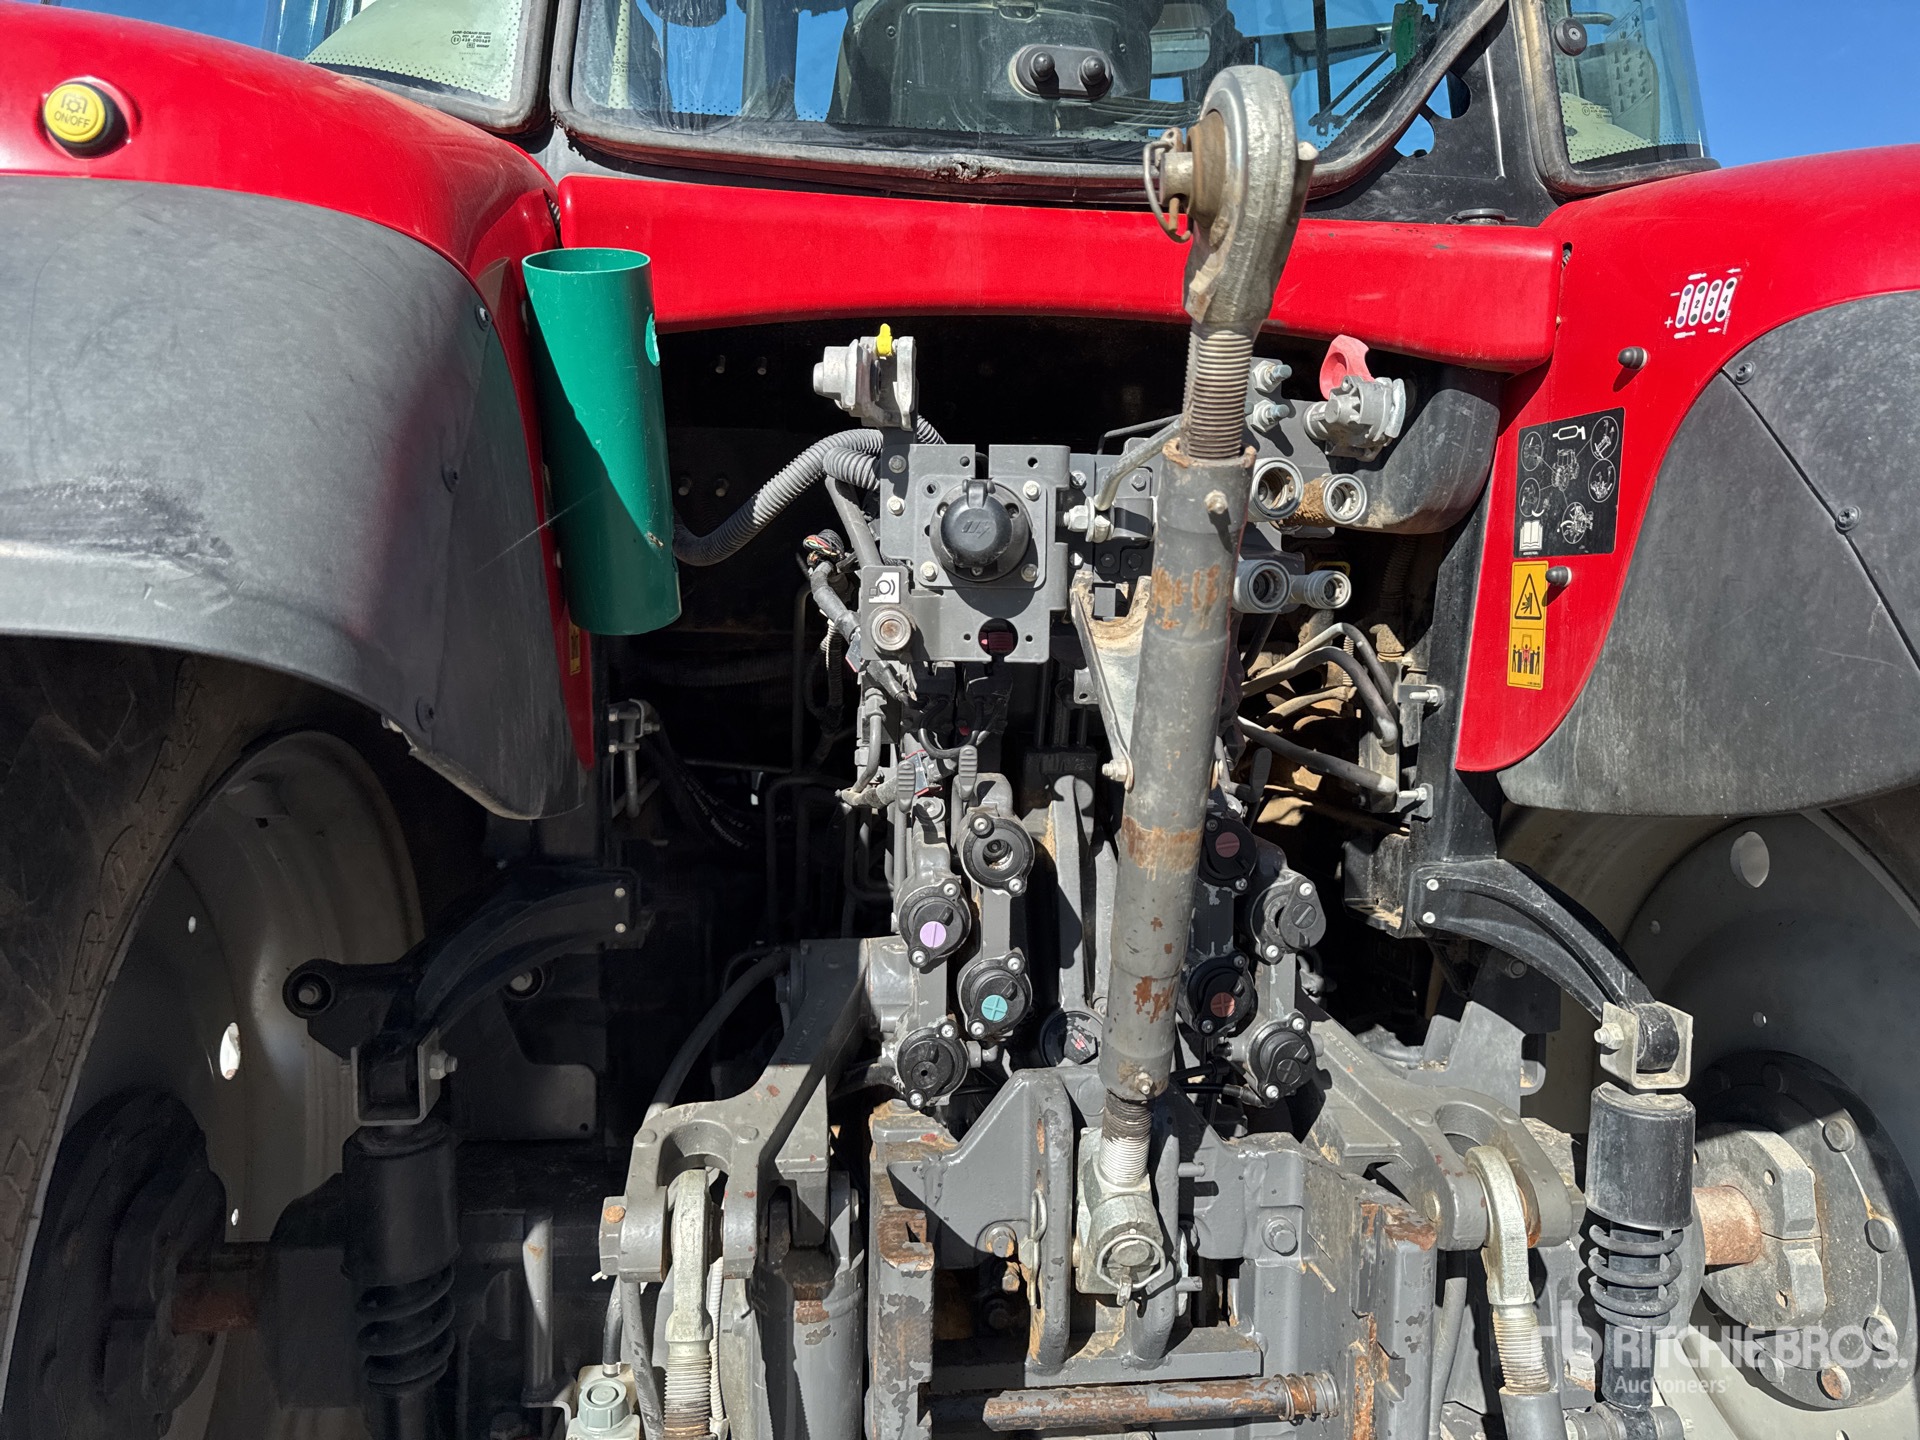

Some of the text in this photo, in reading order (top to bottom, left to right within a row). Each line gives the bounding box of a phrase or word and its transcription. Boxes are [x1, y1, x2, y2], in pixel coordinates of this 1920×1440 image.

[54, 110, 91, 128] ON/OFF
[1694, 300, 1701, 309] 2
[1708, 297, 1715, 307] 3
[1722, 294, 1729, 304] 4
